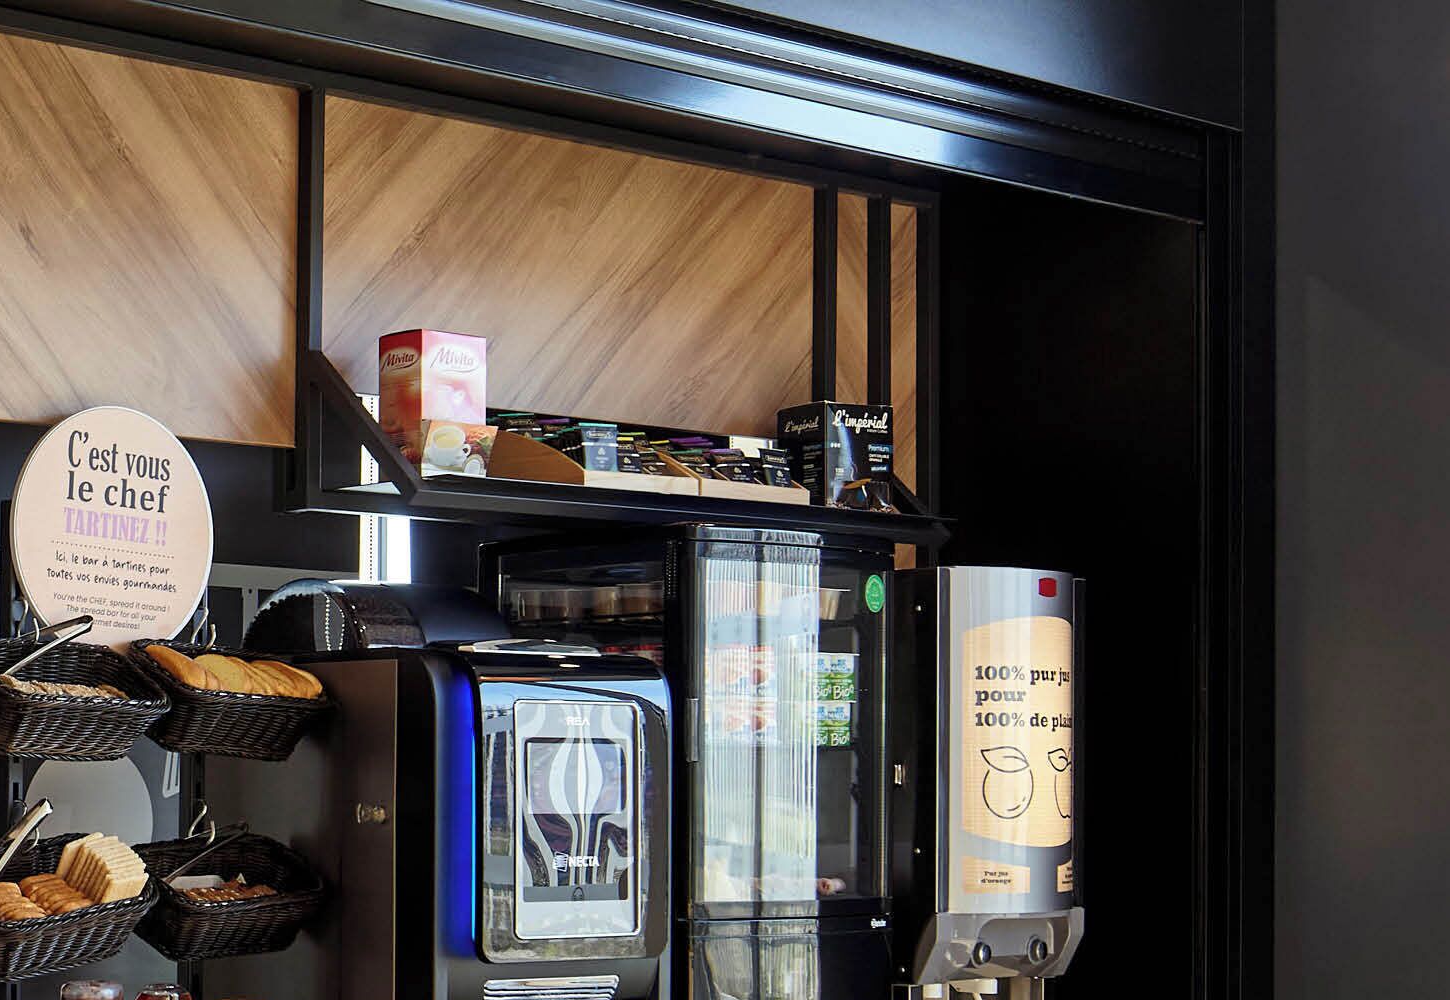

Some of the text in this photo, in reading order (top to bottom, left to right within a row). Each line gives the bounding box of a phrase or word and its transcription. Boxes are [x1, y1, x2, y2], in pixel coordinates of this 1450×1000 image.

[381, 351, 416, 372] Mivita
[68, 430, 170, 481] C'est vous
[66, 470, 170, 513] le chef
[63, 507, 150, 544] TARTINEZ
[55, 550, 170, 577] Ici, le bar à tartines pour
[47, 567, 176, 592] toutes vos envies gourmandes
[53, 592, 75, 601] You're
[76, 594, 88, 603] the
[110, 599, 134, 610] spread
[135, 601, 140, 609] it
[141, 603, 167, 613] around
[66, 604, 157, 623] The spread bar for all your
[975, 666, 1070, 686] 100% pur jus
[975, 690, 1026, 706] pour
[975, 712, 1025, 727] 100%
[1030, 713, 1048, 727] de
[569, 855, 600, 867] NECTA
